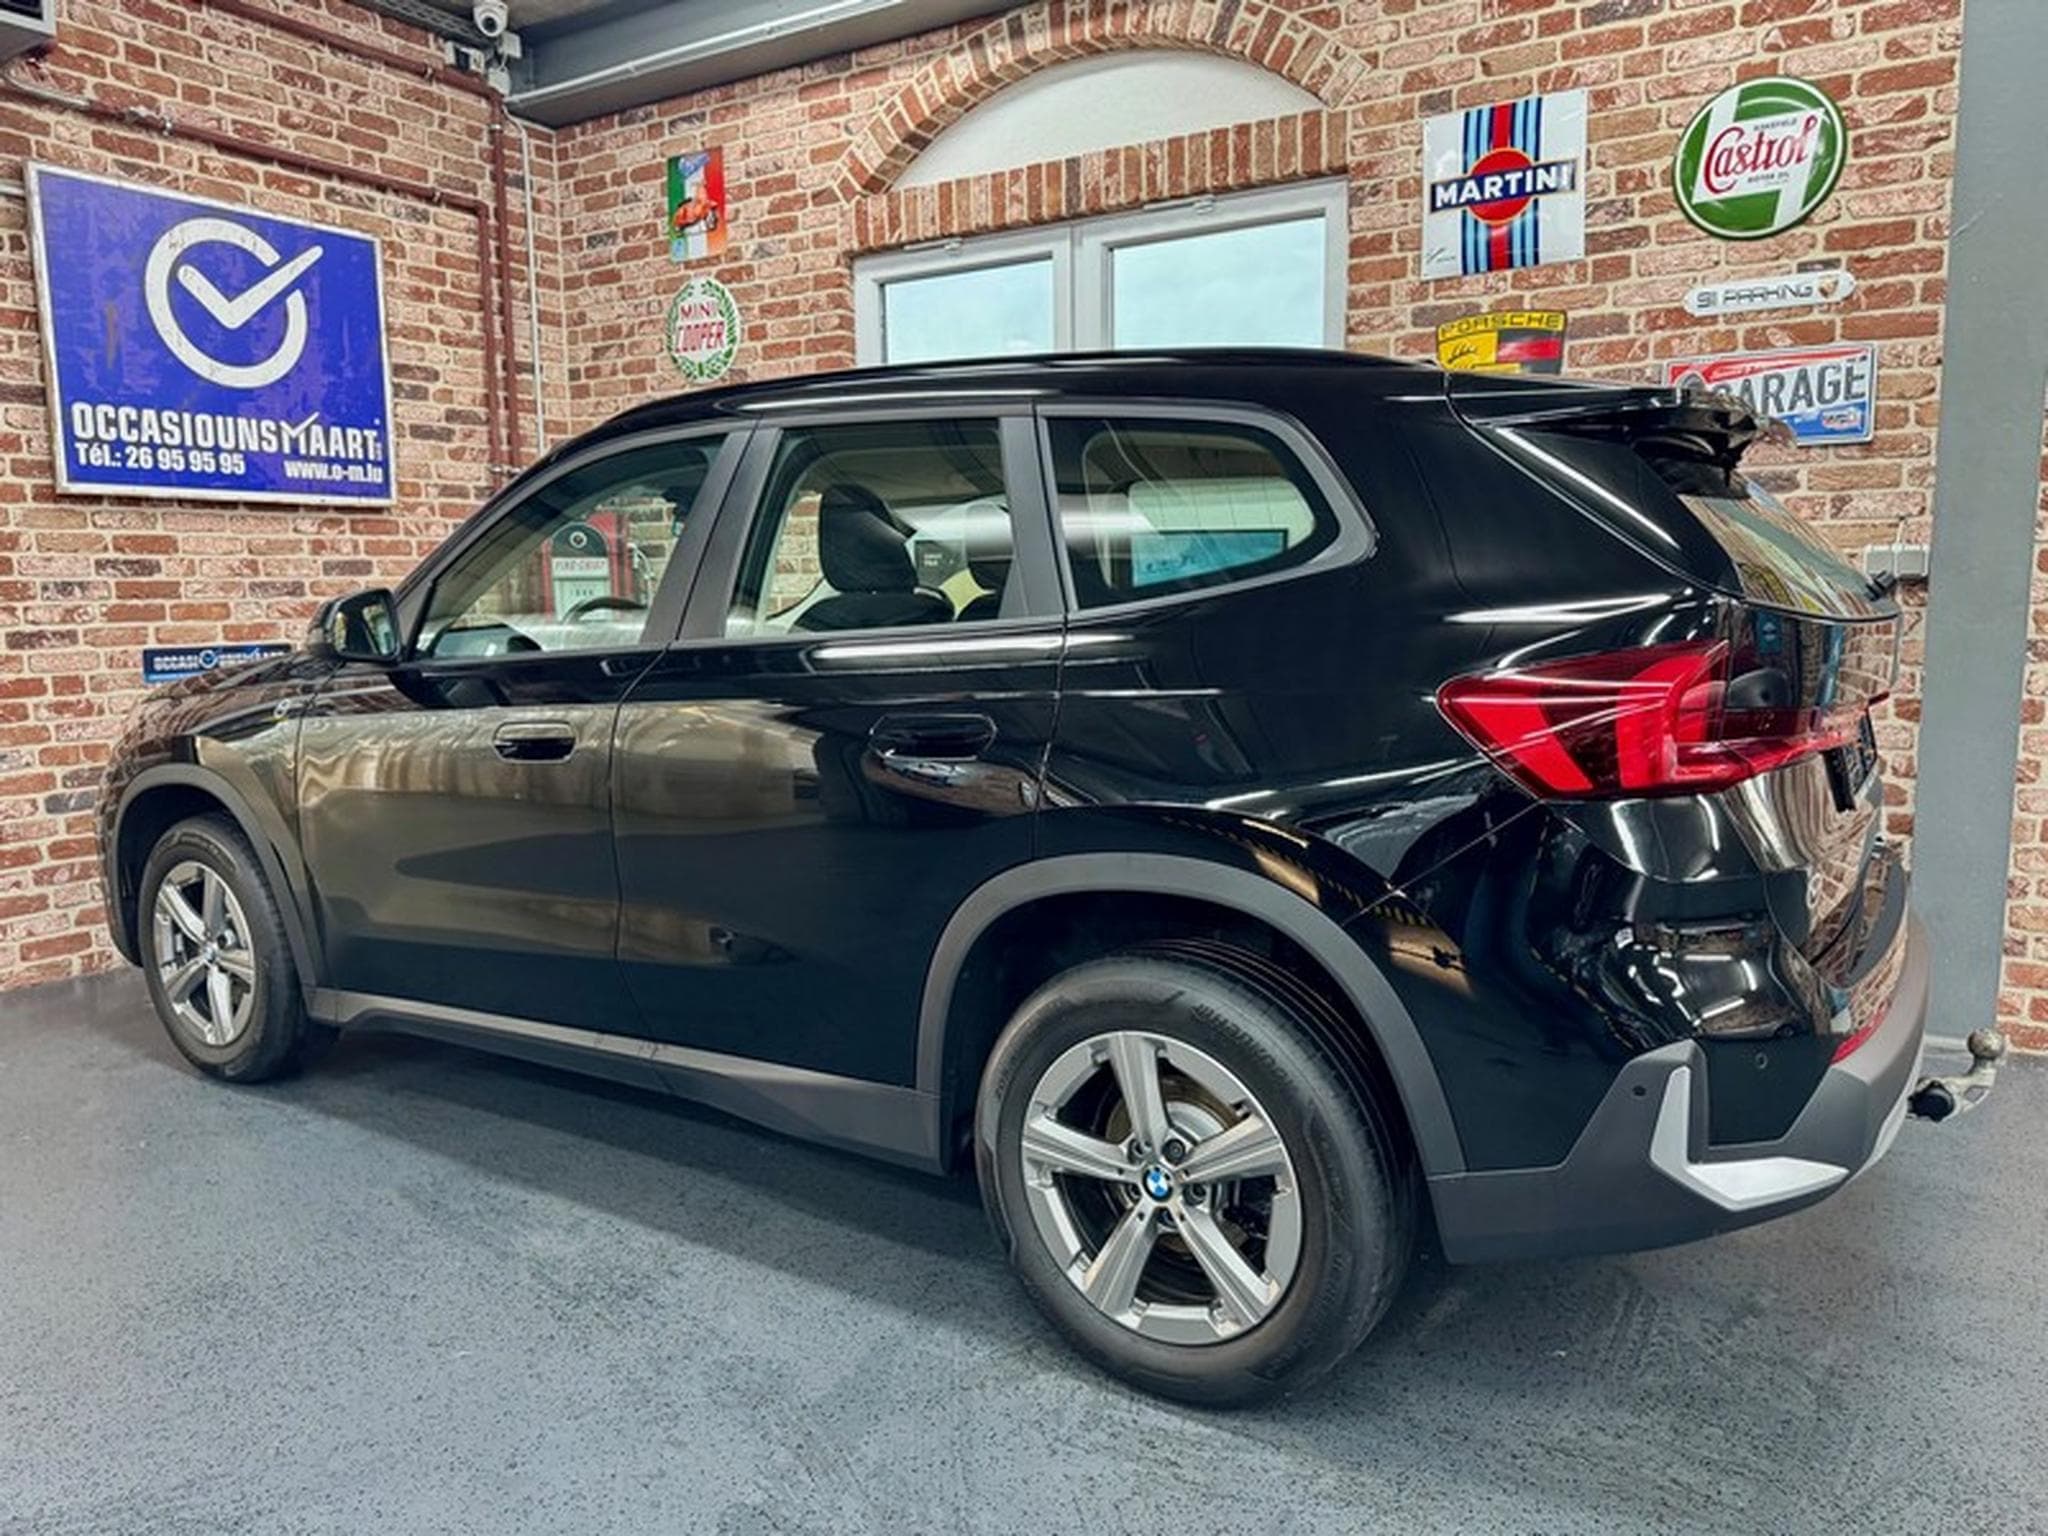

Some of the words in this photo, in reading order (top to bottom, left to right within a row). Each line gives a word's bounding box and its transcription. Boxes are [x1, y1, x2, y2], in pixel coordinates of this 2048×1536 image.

[1703, 114, 1818, 195] Castrol
[1435, 164, 1570, 208] MARTINI
[1723, 284, 1813, 303] PARKING
[675, 321, 725, 352] COOPER
[1440, 313, 1561, 338] PORSCHE
[125, 445, 153, 469] 26
[157, 447, 185, 472] 95
[188, 450, 215, 473] 95
[219, 452, 246, 475] 95
[283, 460, 383, 483] www.o-m.lu
